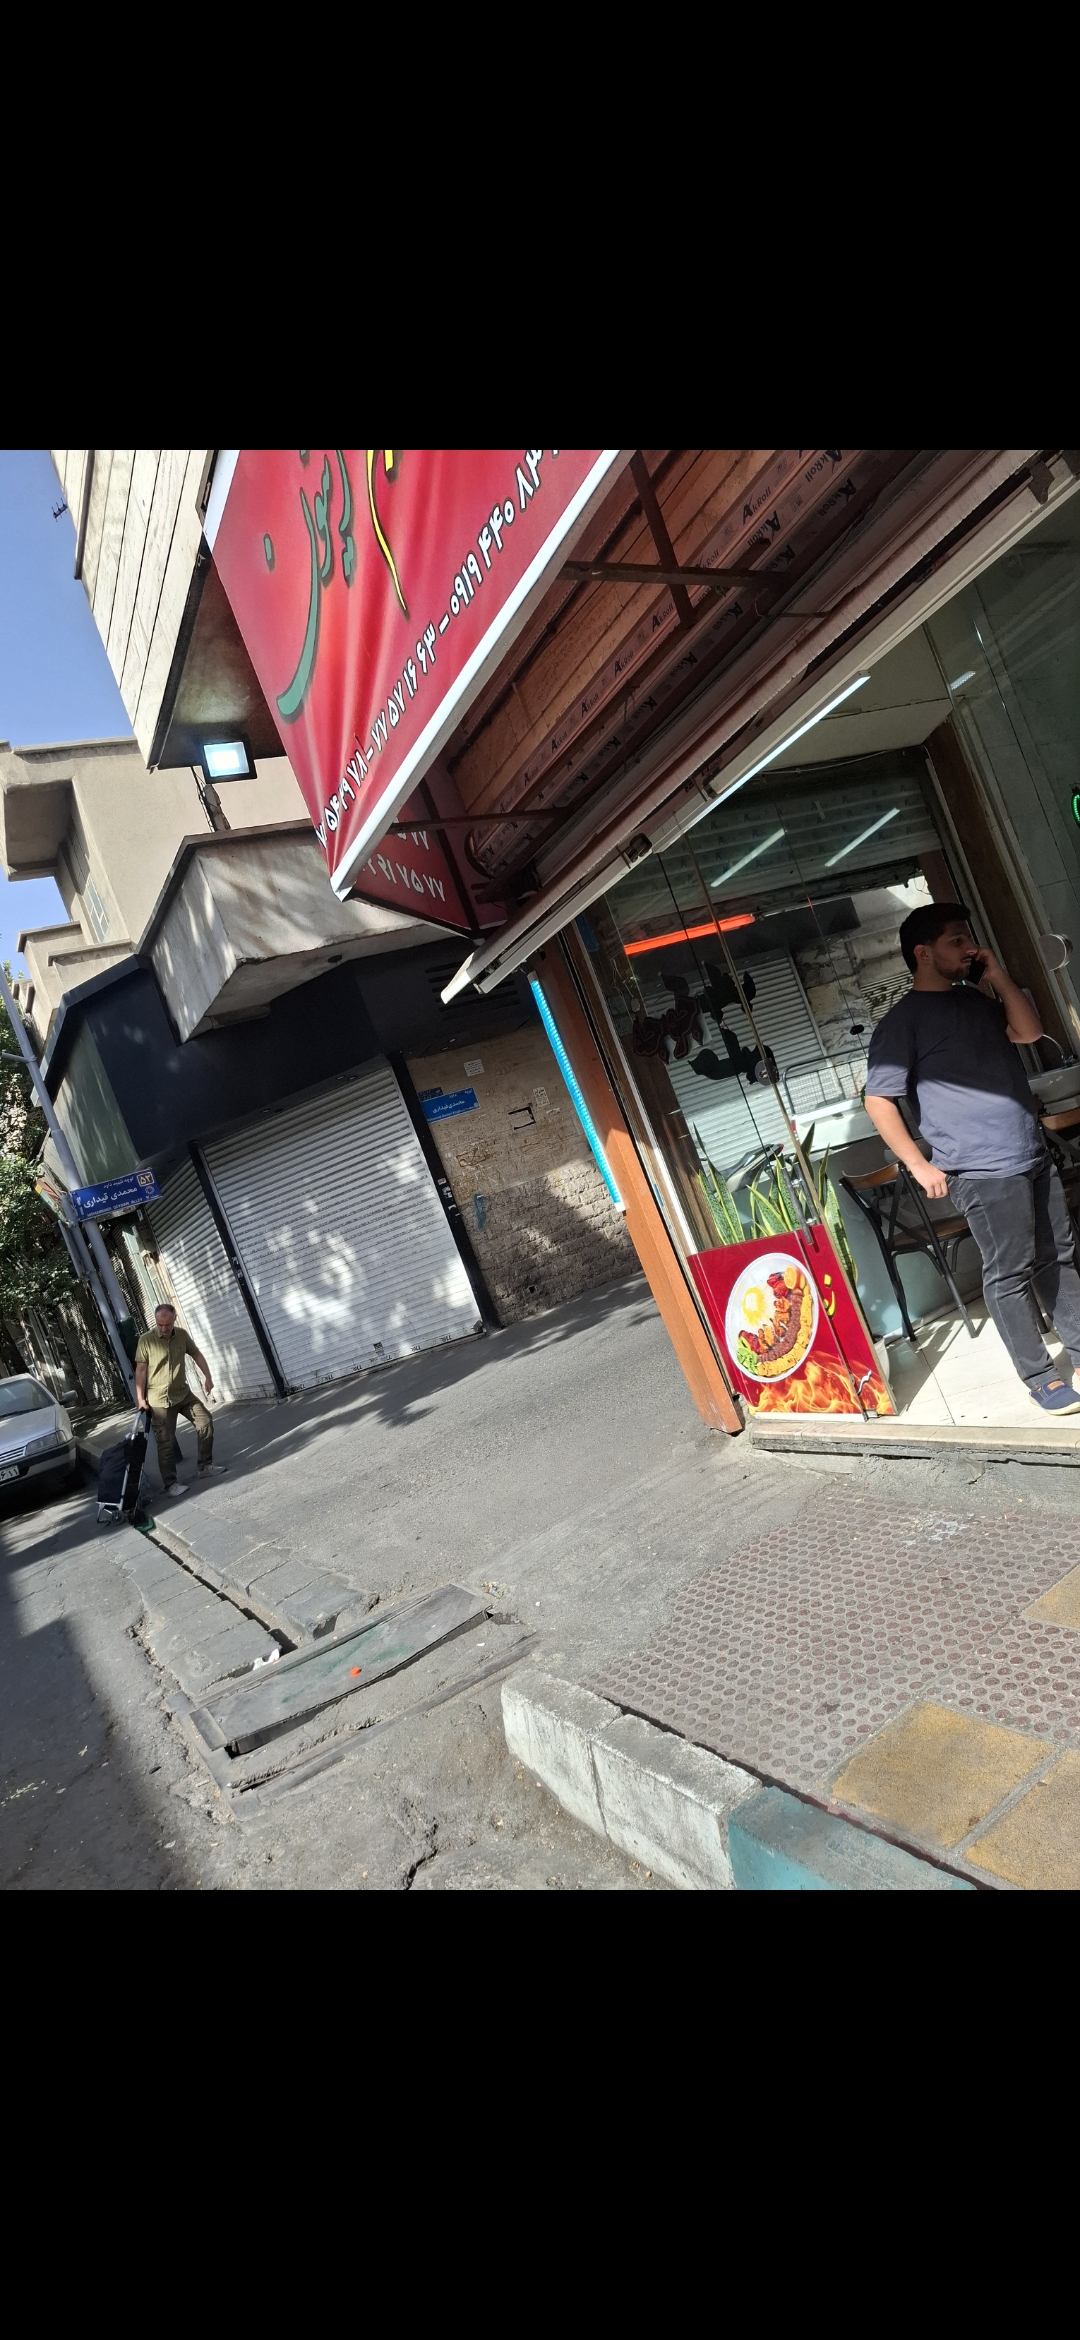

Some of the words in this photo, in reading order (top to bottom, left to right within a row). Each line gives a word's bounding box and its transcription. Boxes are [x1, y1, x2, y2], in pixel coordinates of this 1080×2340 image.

[743, 486, 772, 526] AkRoll
[818, 478, 857, 517] AkRoll
[450, 551, 483, 617] ۰۹۱۹
[83, 1193, 109, 1208] قیداری
[110, 1187, 138, 1201] محمدی
